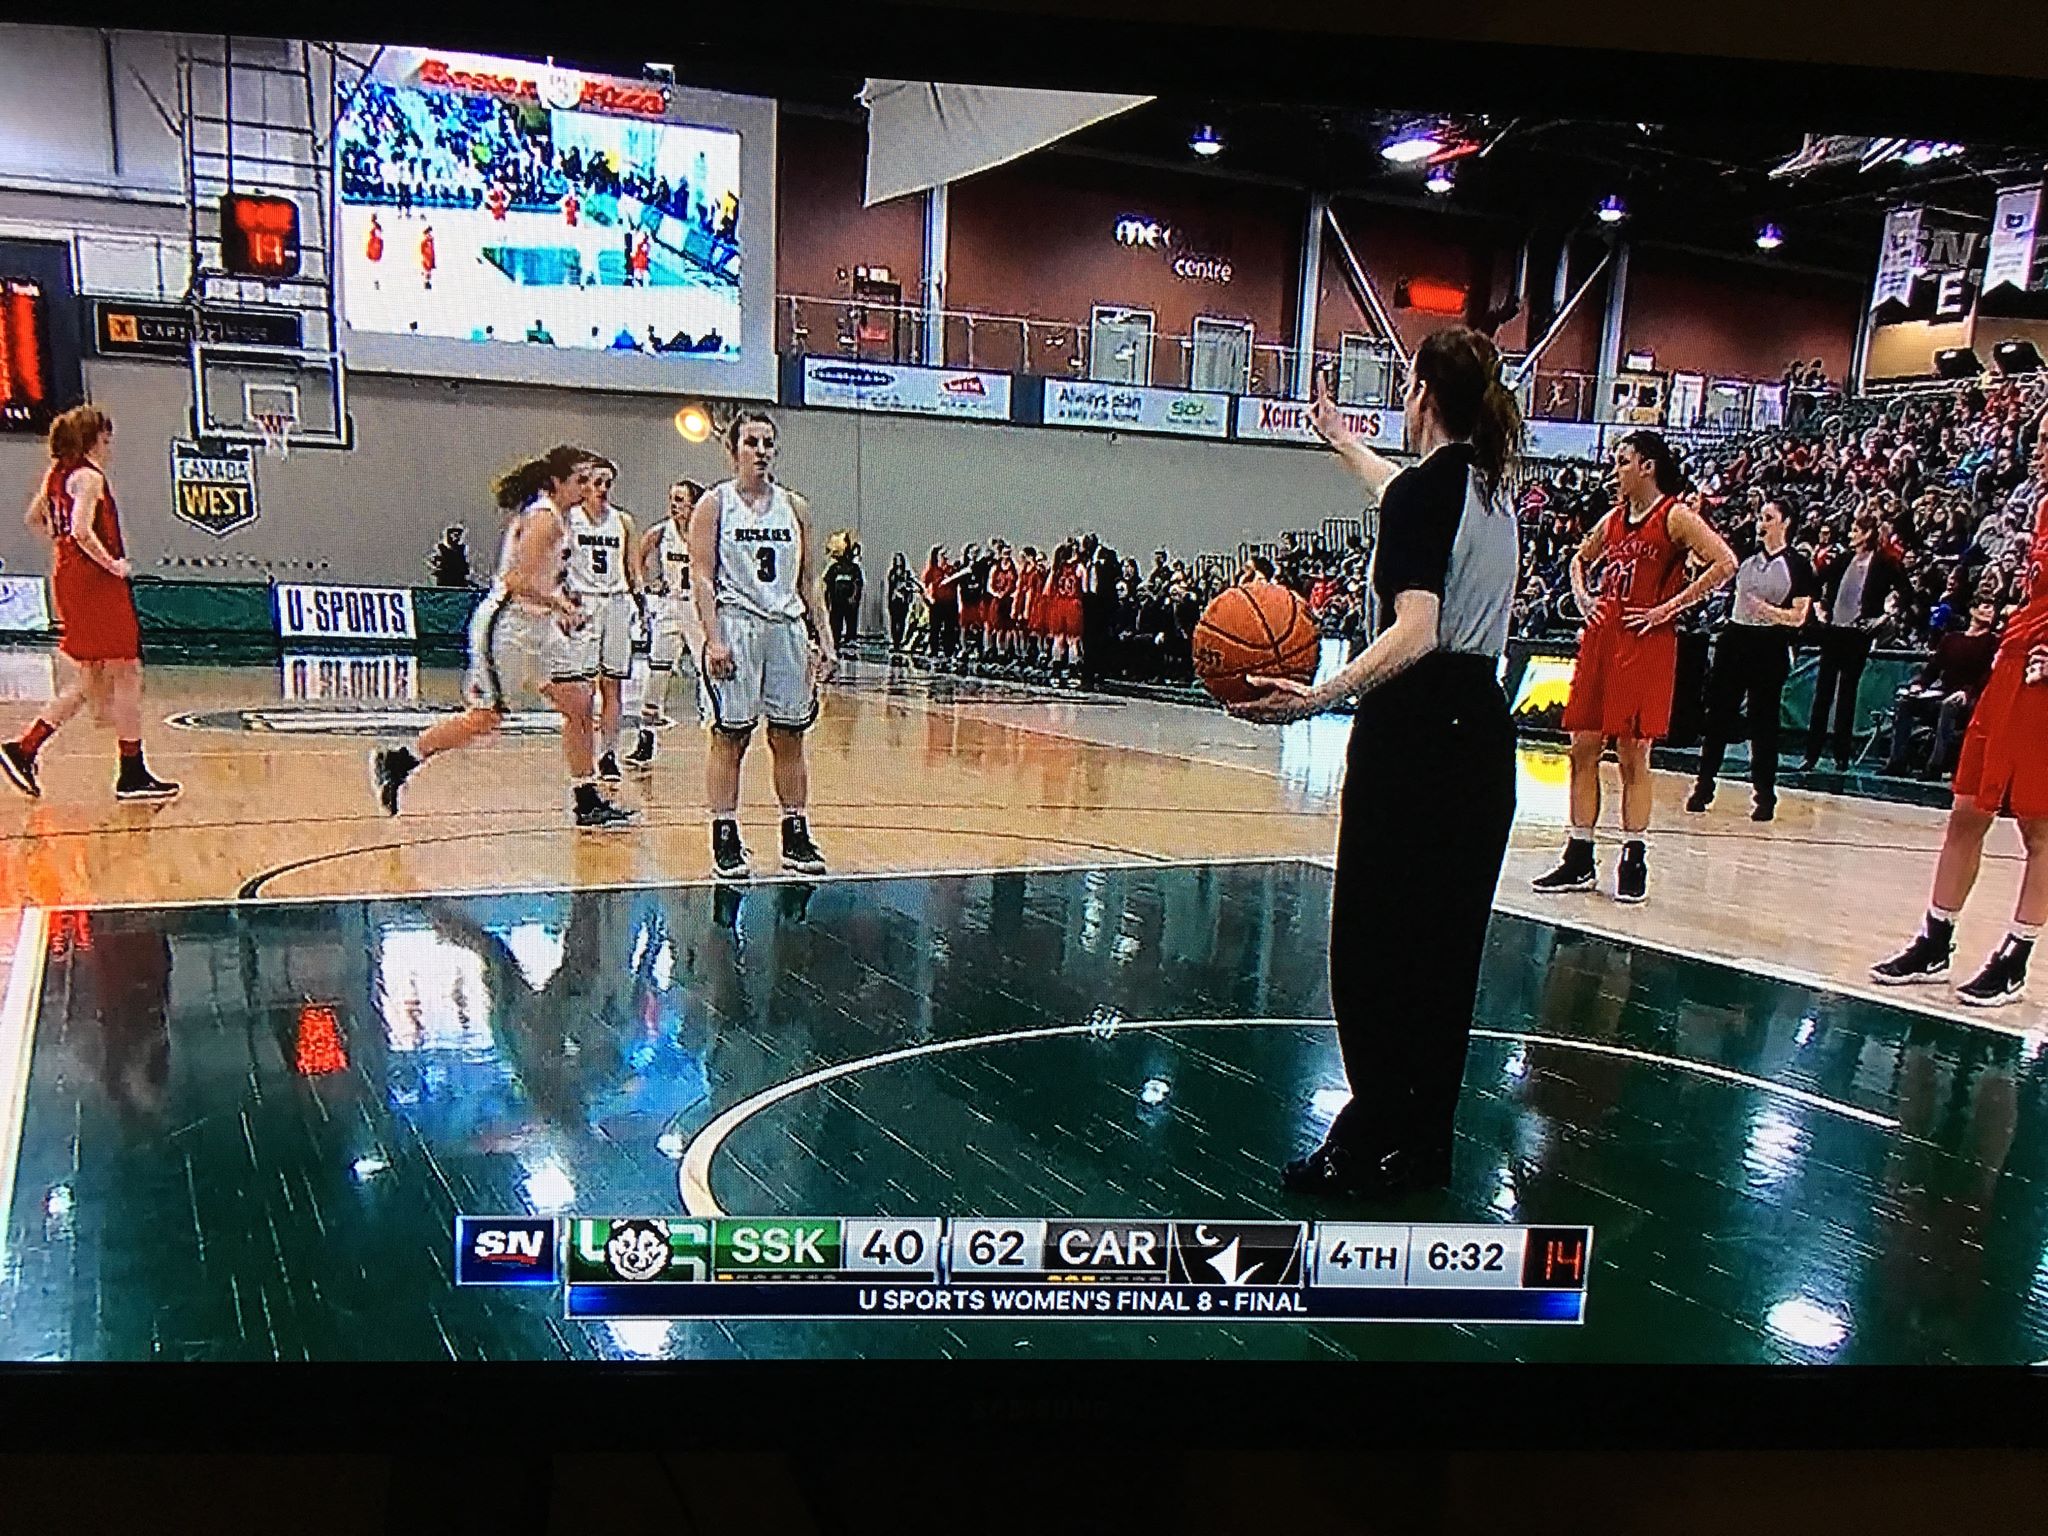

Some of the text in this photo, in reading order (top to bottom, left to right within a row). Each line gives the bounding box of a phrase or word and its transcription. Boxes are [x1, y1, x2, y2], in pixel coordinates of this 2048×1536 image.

[1174, 257, 1233, 283] centre
[180, 459, 249, 481] CANADA
[182, 482, 248, 518] WEST
[591, 550, 608, 575] 5
[756, 546, 777, 583] 3
[474, 1229, 544, 1258] SN
[731, 1227, 925, 1265] SSK 40
[968, 1229, 1157, 1267] 62 CAR
[1329, 1240, 1582, 1280] 4TH 6:32 14
[858, 1288, 878, 1310] U
[883, 1289, 986, 1311] SPORTS
[991, 1289, 1111, 1312] WOMEN'S
[1116, 1290, 1191, 1312] FINAL
[1196, 1291, 1213, 1312] 8
[1234, 1291, 1308, 1312] FINAL
